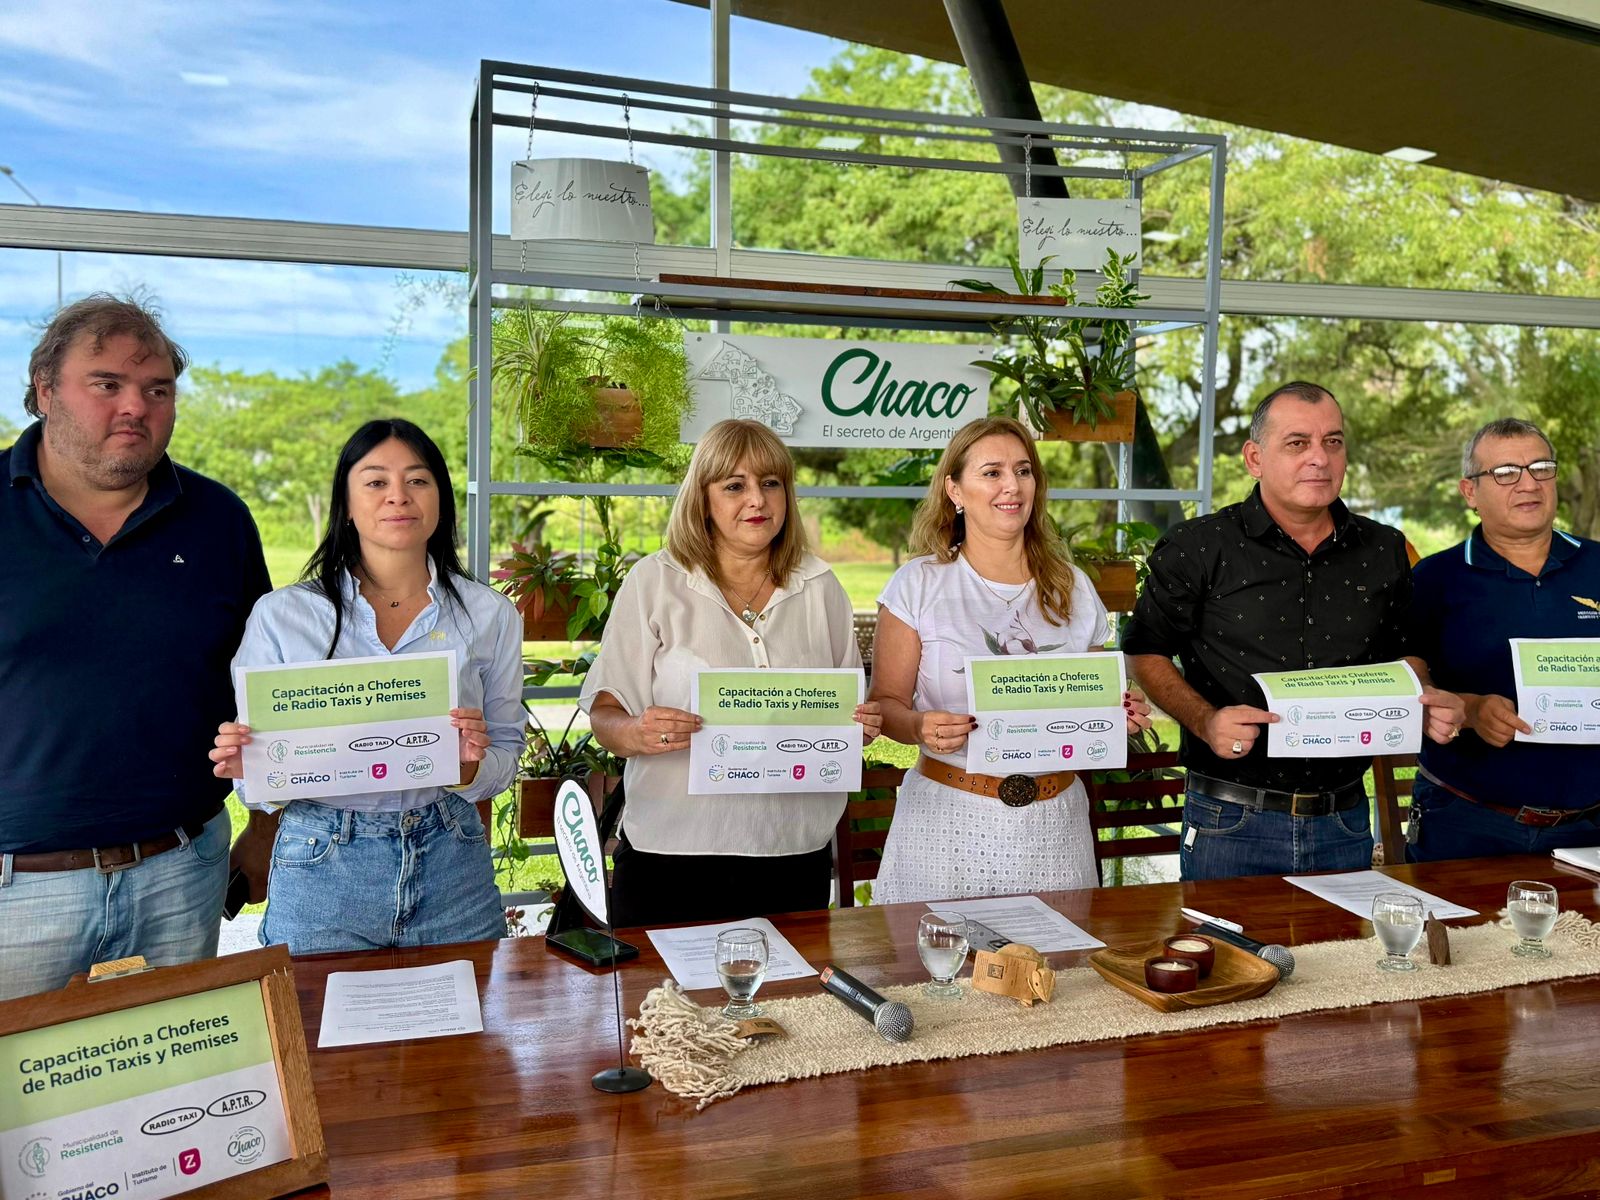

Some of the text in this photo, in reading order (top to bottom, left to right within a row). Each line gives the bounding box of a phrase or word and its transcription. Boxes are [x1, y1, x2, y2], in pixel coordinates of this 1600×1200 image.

[557, 180, 576, 201] lo
[1058, 218, 1073, 236] lo
[821, 348, 977, 418] Chaco
[823, 425, 957, 441] El secreto de Argenti
[1537, 654, 1595, 664] Capacitación
[1551, 664, 1576, 673] Radio
[1579, 664, 1600, 673] Taxis
[991, 673, 1050, 684] Capacitación
[1060, 671, 1099, 681] Choferes
[1281, 673, 1340, 683] Capacitación
[1348, 670, 1388, 679] Choferes
[1298, 680, 1324, 688] Radio
[1359, 677, 1395, 685] Remises
[271, 678, 421, 700] Capacitación a Choferes
[718, 687, 836, 698] Capacitación a Choferes
[992, 683, 1103, 694] de Radio Taxis y Remises
[273, 690, 426, 712] de Radio Taxis y Remises
[718, 699, 839, 710] de Radio Taxis y Remises
[406, 734, 430, 745] A.P.T.R.
[294, 747, 336, 756] Resistencia
[1065, 747, 1070, 755] Z
[376, 766, 384, 775] Z
[406, 762, 431, 773] Chaco
[795, 767, 802, 775] Z
[820, 766, 839, 777] Chaco
[291, 774, 330, 785] CHACO
[562, 791, 600, 883] Chaco
[19, 1015, 230, 1074] Capacitación a Choferes
[22, 1030, 239, 1095] de Radio Taxis y Remises
[222, 1095, 253, 1113] A.P.T.R.
[149, 1111, 197, 1131] RADIO TAXI
[62, 1131, 109, 1149] Municipalidad
[60, 1135, 124, 1160] Resistencia
[227, 1136, 261, 1158] Chaco
[184, 1154, 196, 1169] Z
[131, 1166, 158, 1179] Instituto
[132, 1174, 158, 1186] Turismo
[61, 1183, 119, 1200] HACO
